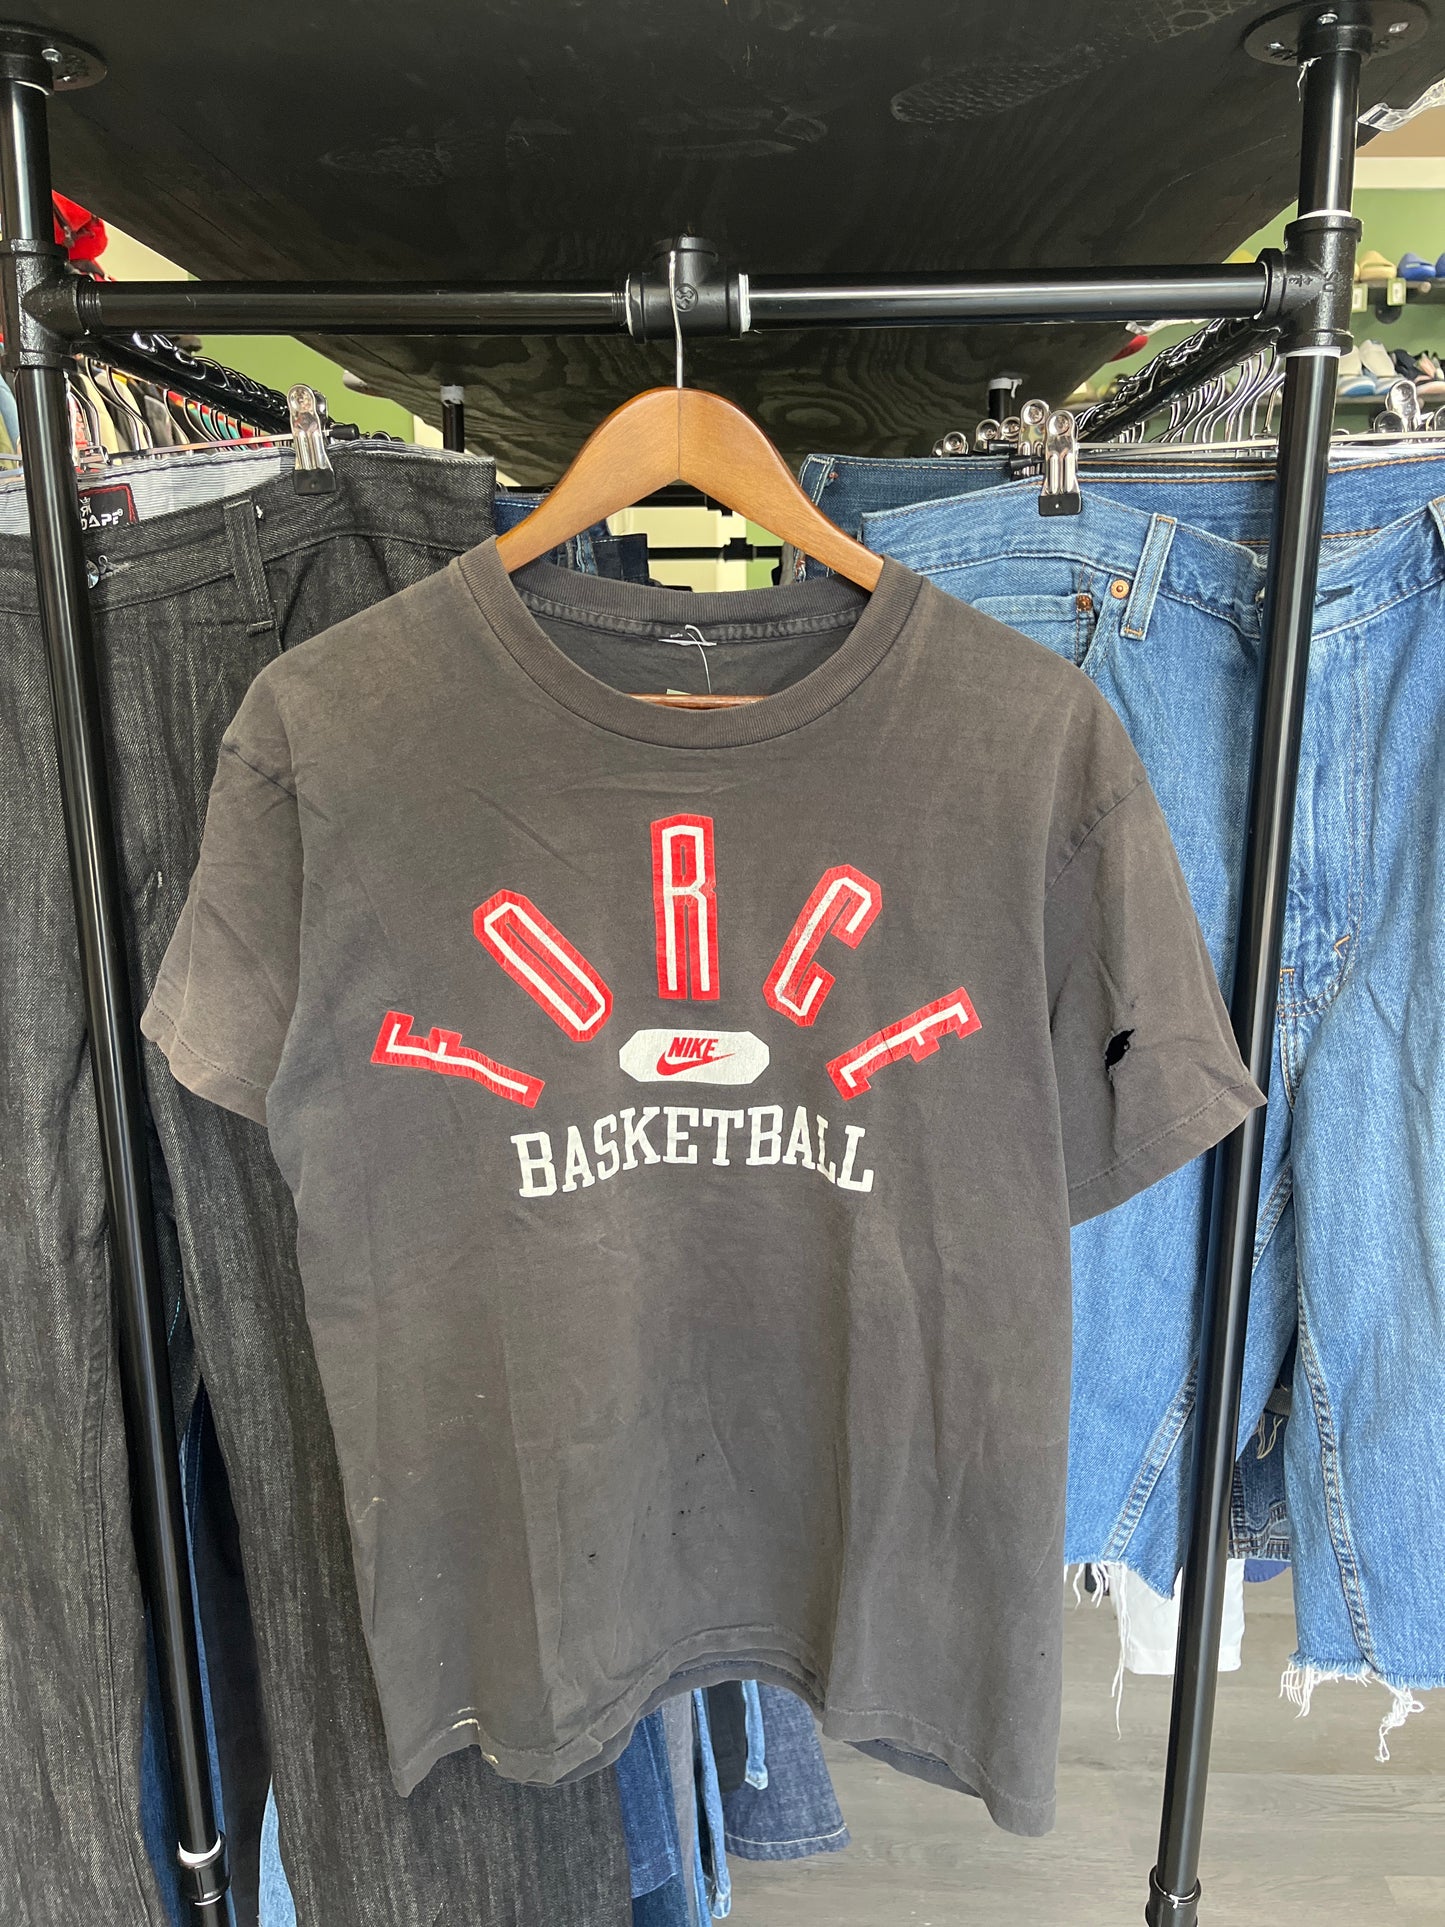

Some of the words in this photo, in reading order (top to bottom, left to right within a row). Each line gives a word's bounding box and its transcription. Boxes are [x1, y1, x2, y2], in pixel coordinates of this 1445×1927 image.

[371, 813, 982, 1107] FORCE
[667, 1037, 718, 1060] NIKE
[511, 1105, 874, 1198] BASKETBALL
